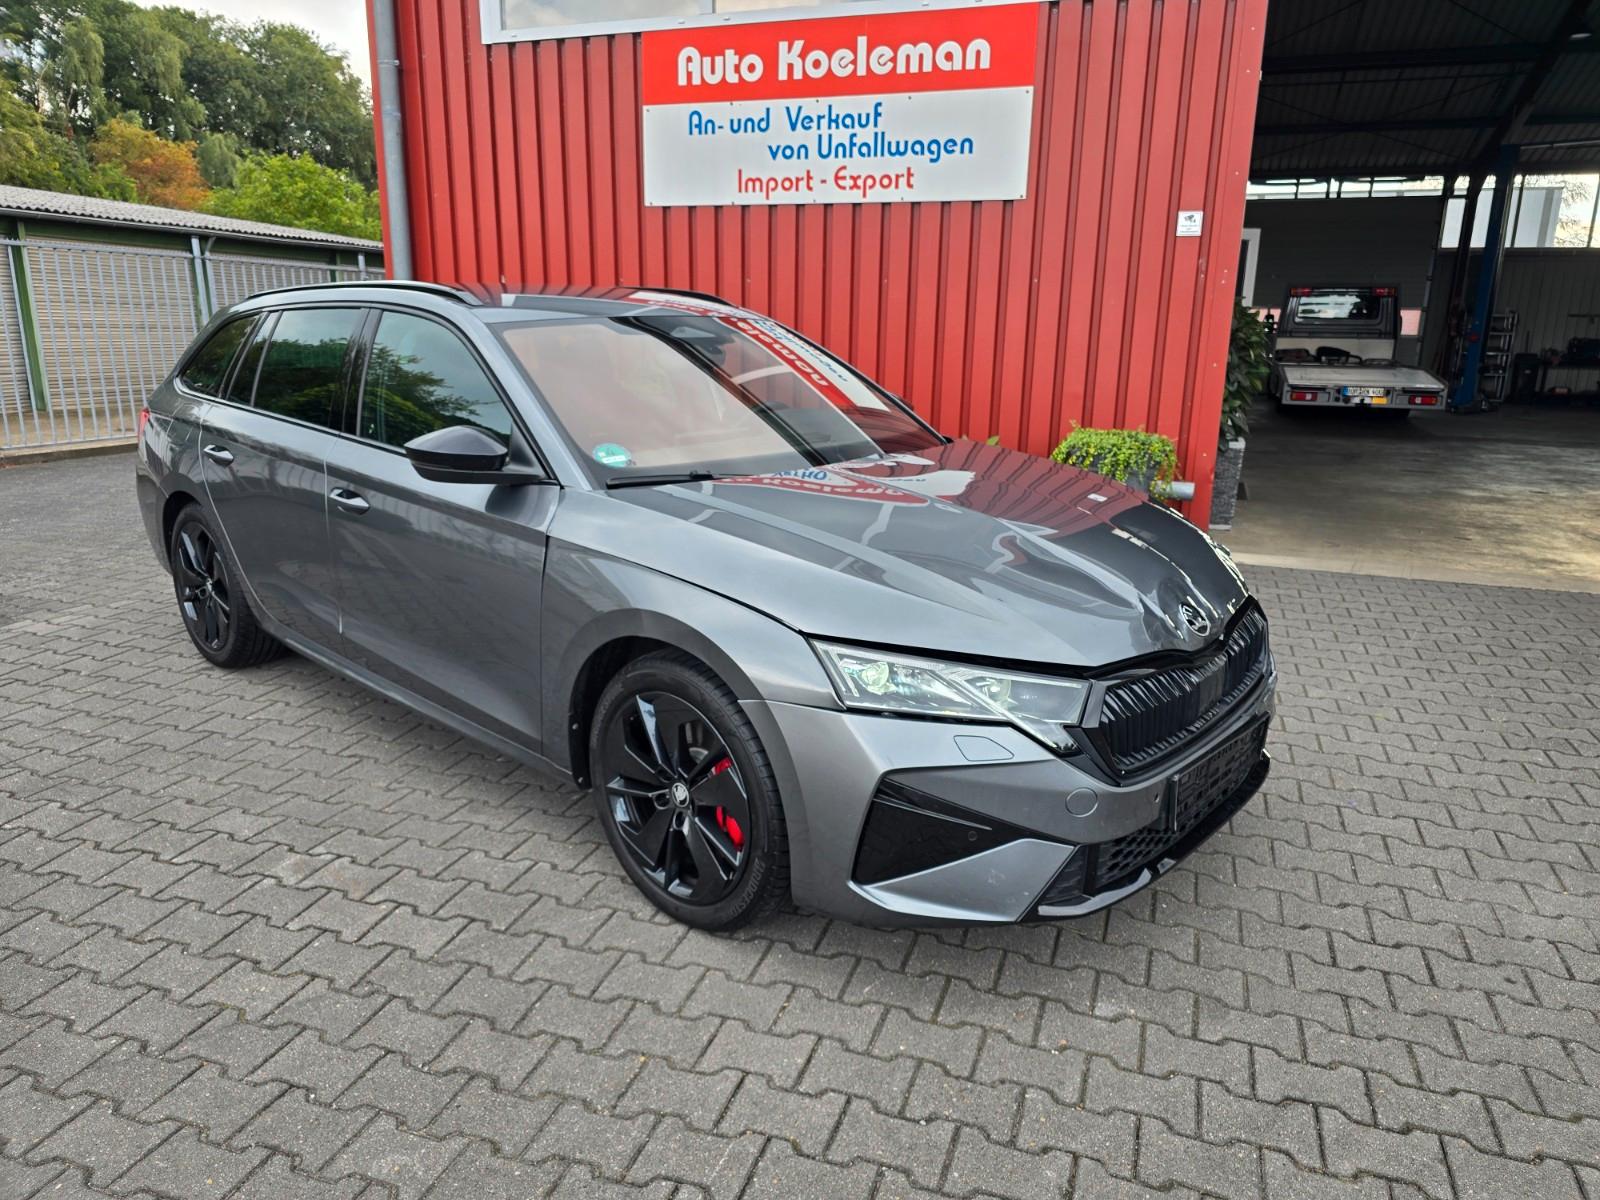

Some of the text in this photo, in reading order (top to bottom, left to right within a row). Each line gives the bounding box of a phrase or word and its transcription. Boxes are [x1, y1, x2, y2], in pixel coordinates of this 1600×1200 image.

[677, 35, 991, 86] Auto Koeleman
[729, 107, 771, 135] und
[785, 101, 883, 132] Verkauf
[767, 131, 975, 163] von Unfallwagen
